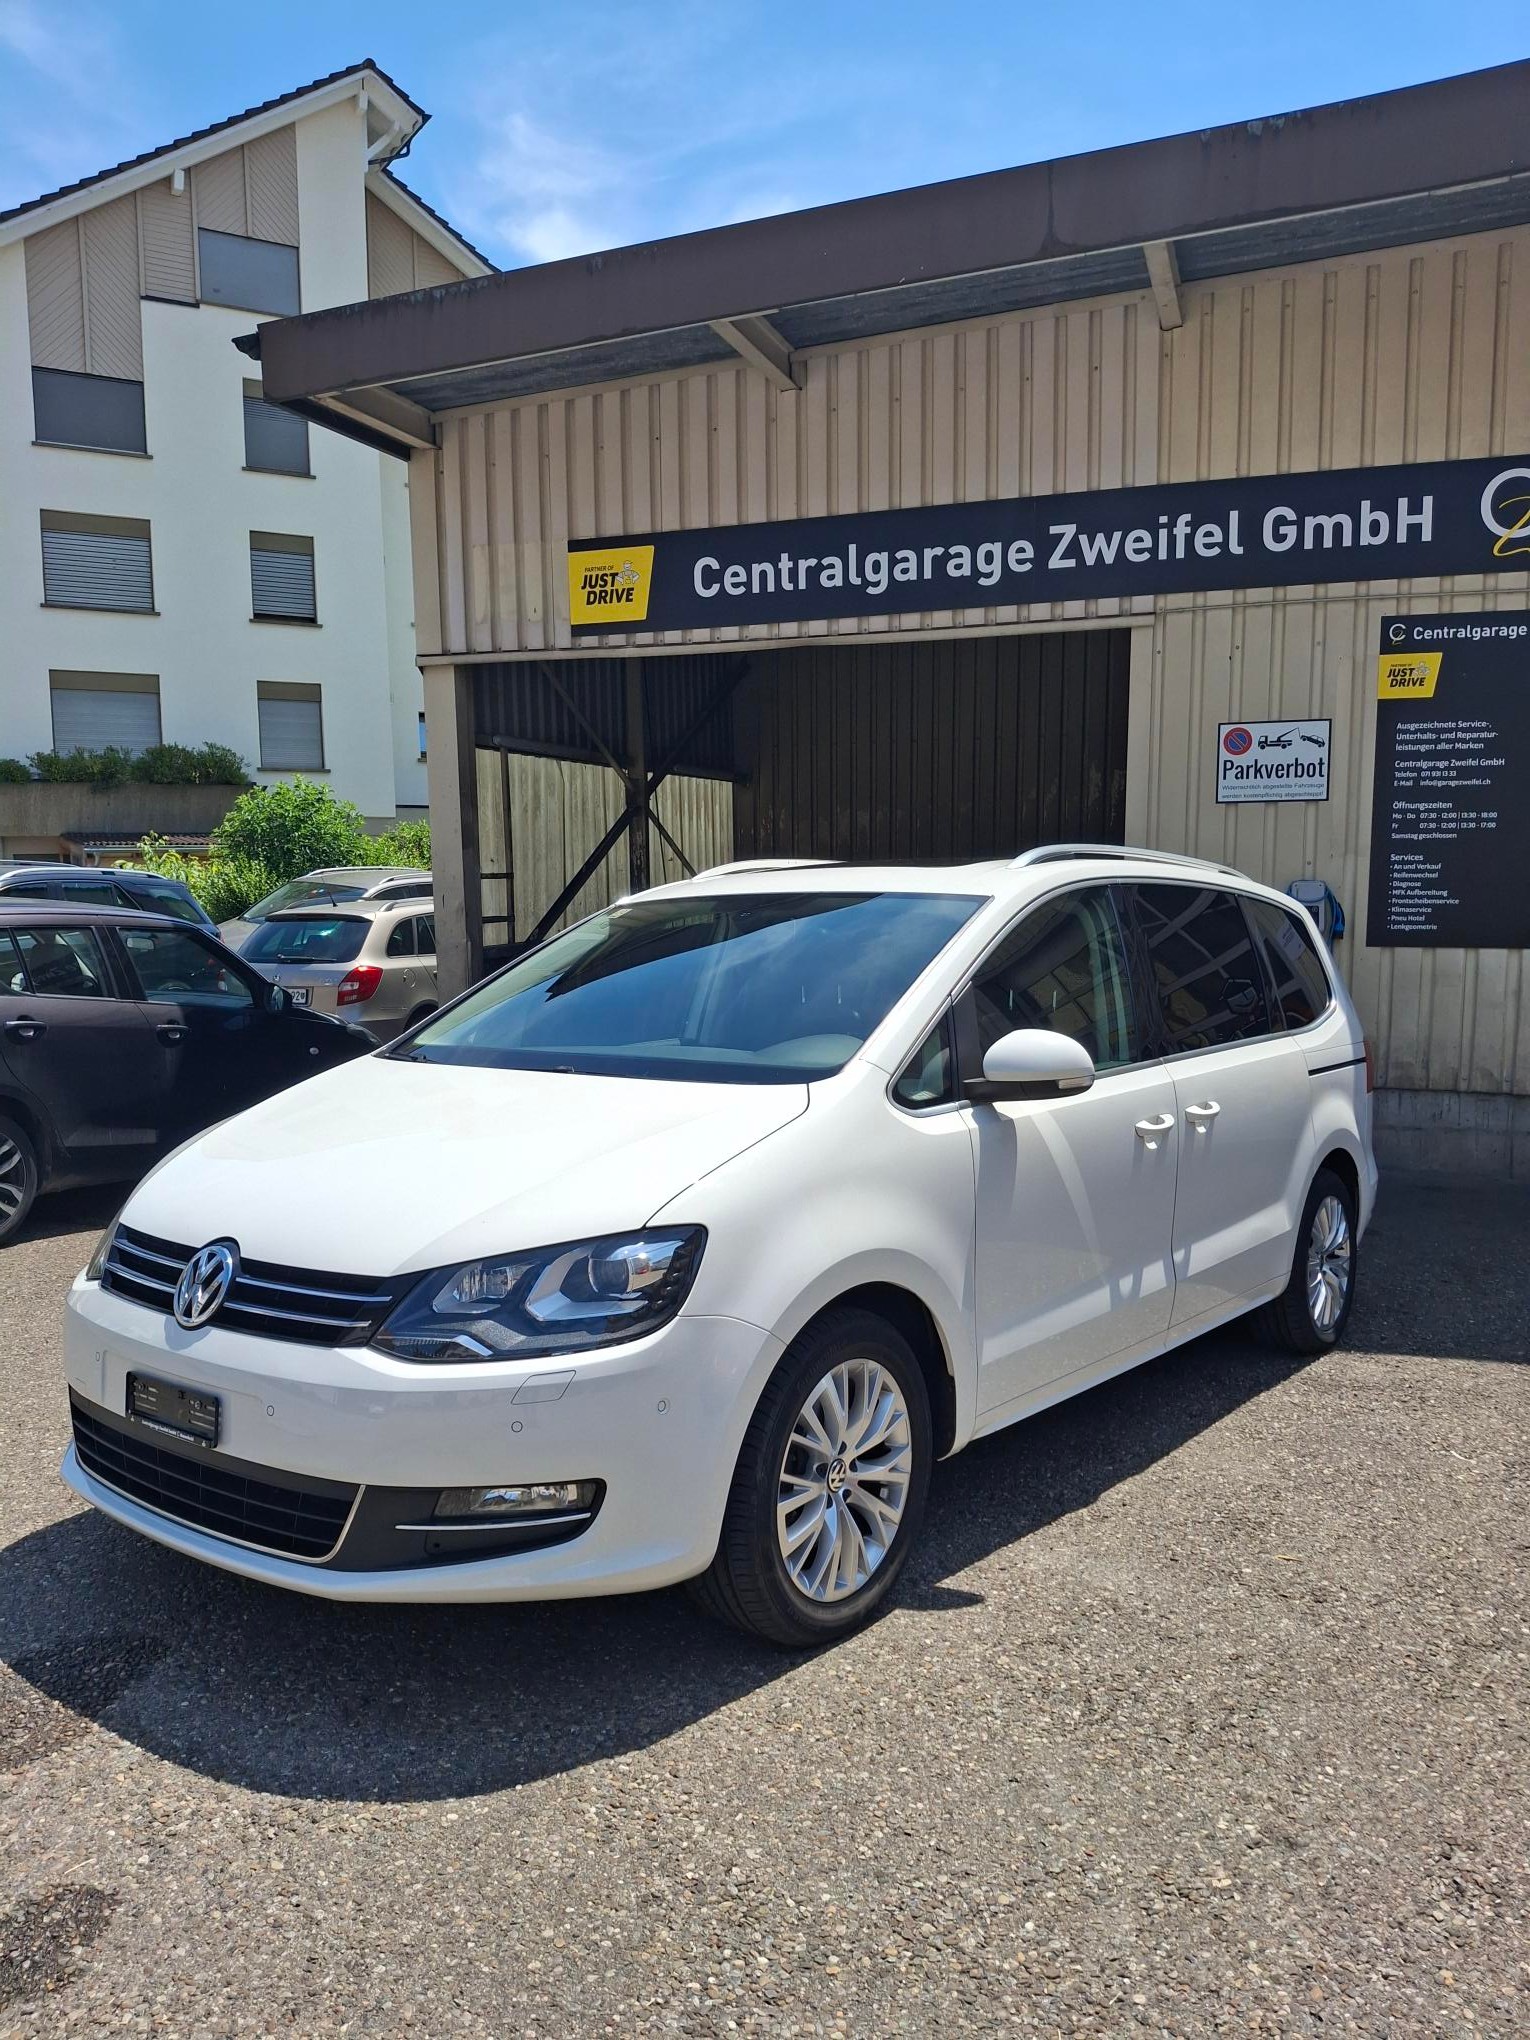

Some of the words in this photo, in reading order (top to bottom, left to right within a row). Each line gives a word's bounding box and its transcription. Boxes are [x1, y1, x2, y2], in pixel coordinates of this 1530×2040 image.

[693, 539, 1035, 599] Centralgarage
[1048, 510, 1244, 570] Zweifel
[1262, 495, 1434, 553] GmbH
[581, 572, 619, 590] JUST
[586, 587, 634, 606] DRIVE
[1413, 624, 1528, 640] Centralgarage
[1387, 668, 1415, 678] JUST
[1390, 677, 1426, 688] DRIVE
[1396, 721, 1457, 731] Ausgezeichnete
[1396, 732, 1439, 740] Unterhalts-
[1456, 731, 1499, 740] Reparatur-
[1396, 743, 1435, 752] leistungen
[1436, 742, 1453, 750] aller
[1455, 742, 1484, 750] Marken
[1222, 757, 1325, 780] Parkverbot
[1395, 760, 1450, 769] Centralgarage
[1450, 758, 1479, 767] Zweifel
[1480, 758, 1505, 766] GmbH
[1393, 801, 1452, 810] Öffnungszeiten
[1391, 832, 1418, 840] Samstag
[1406, 889, 1448, 897] Aufbereitung
[1390, 923, 1437, 931] Lenkgeometrie
